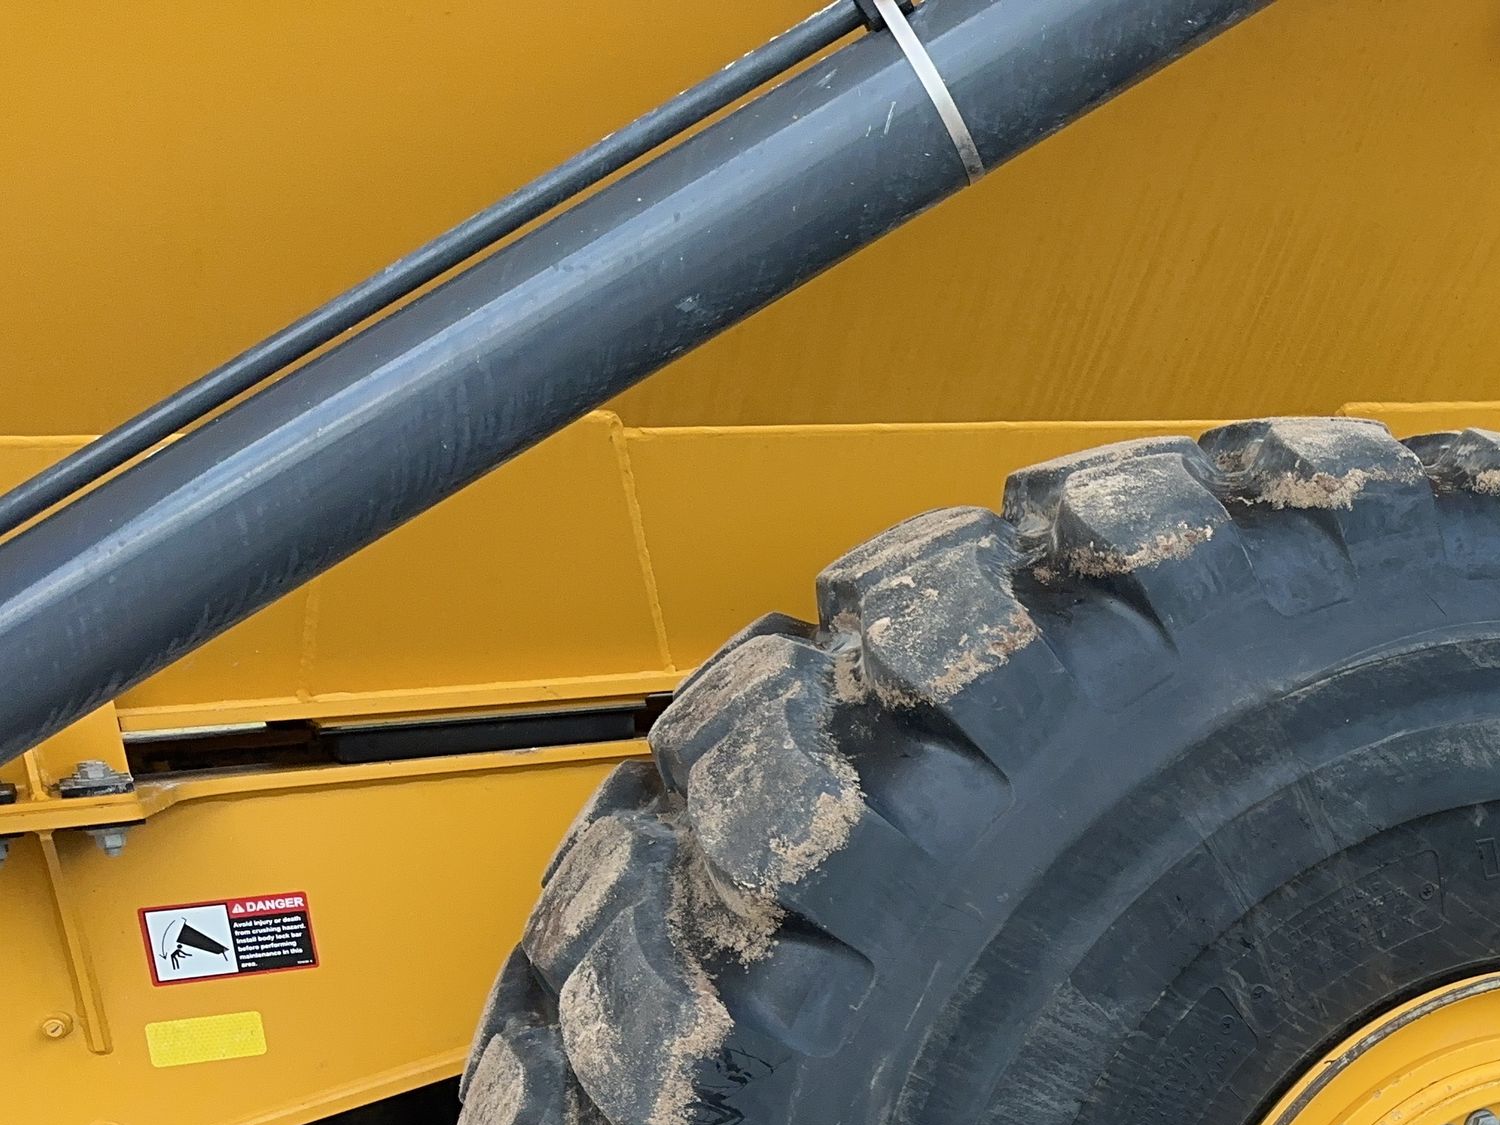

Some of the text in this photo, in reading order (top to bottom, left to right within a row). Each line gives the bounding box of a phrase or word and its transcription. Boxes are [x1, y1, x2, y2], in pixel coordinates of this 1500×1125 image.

[245, 896, 304, 912] DANGER
[233, 920, 253, 928] Avoid
[252, 926, 281, 934] crushing
[261, 940, 297, 950] performing
[239, 951, 281, 960] maintenance
